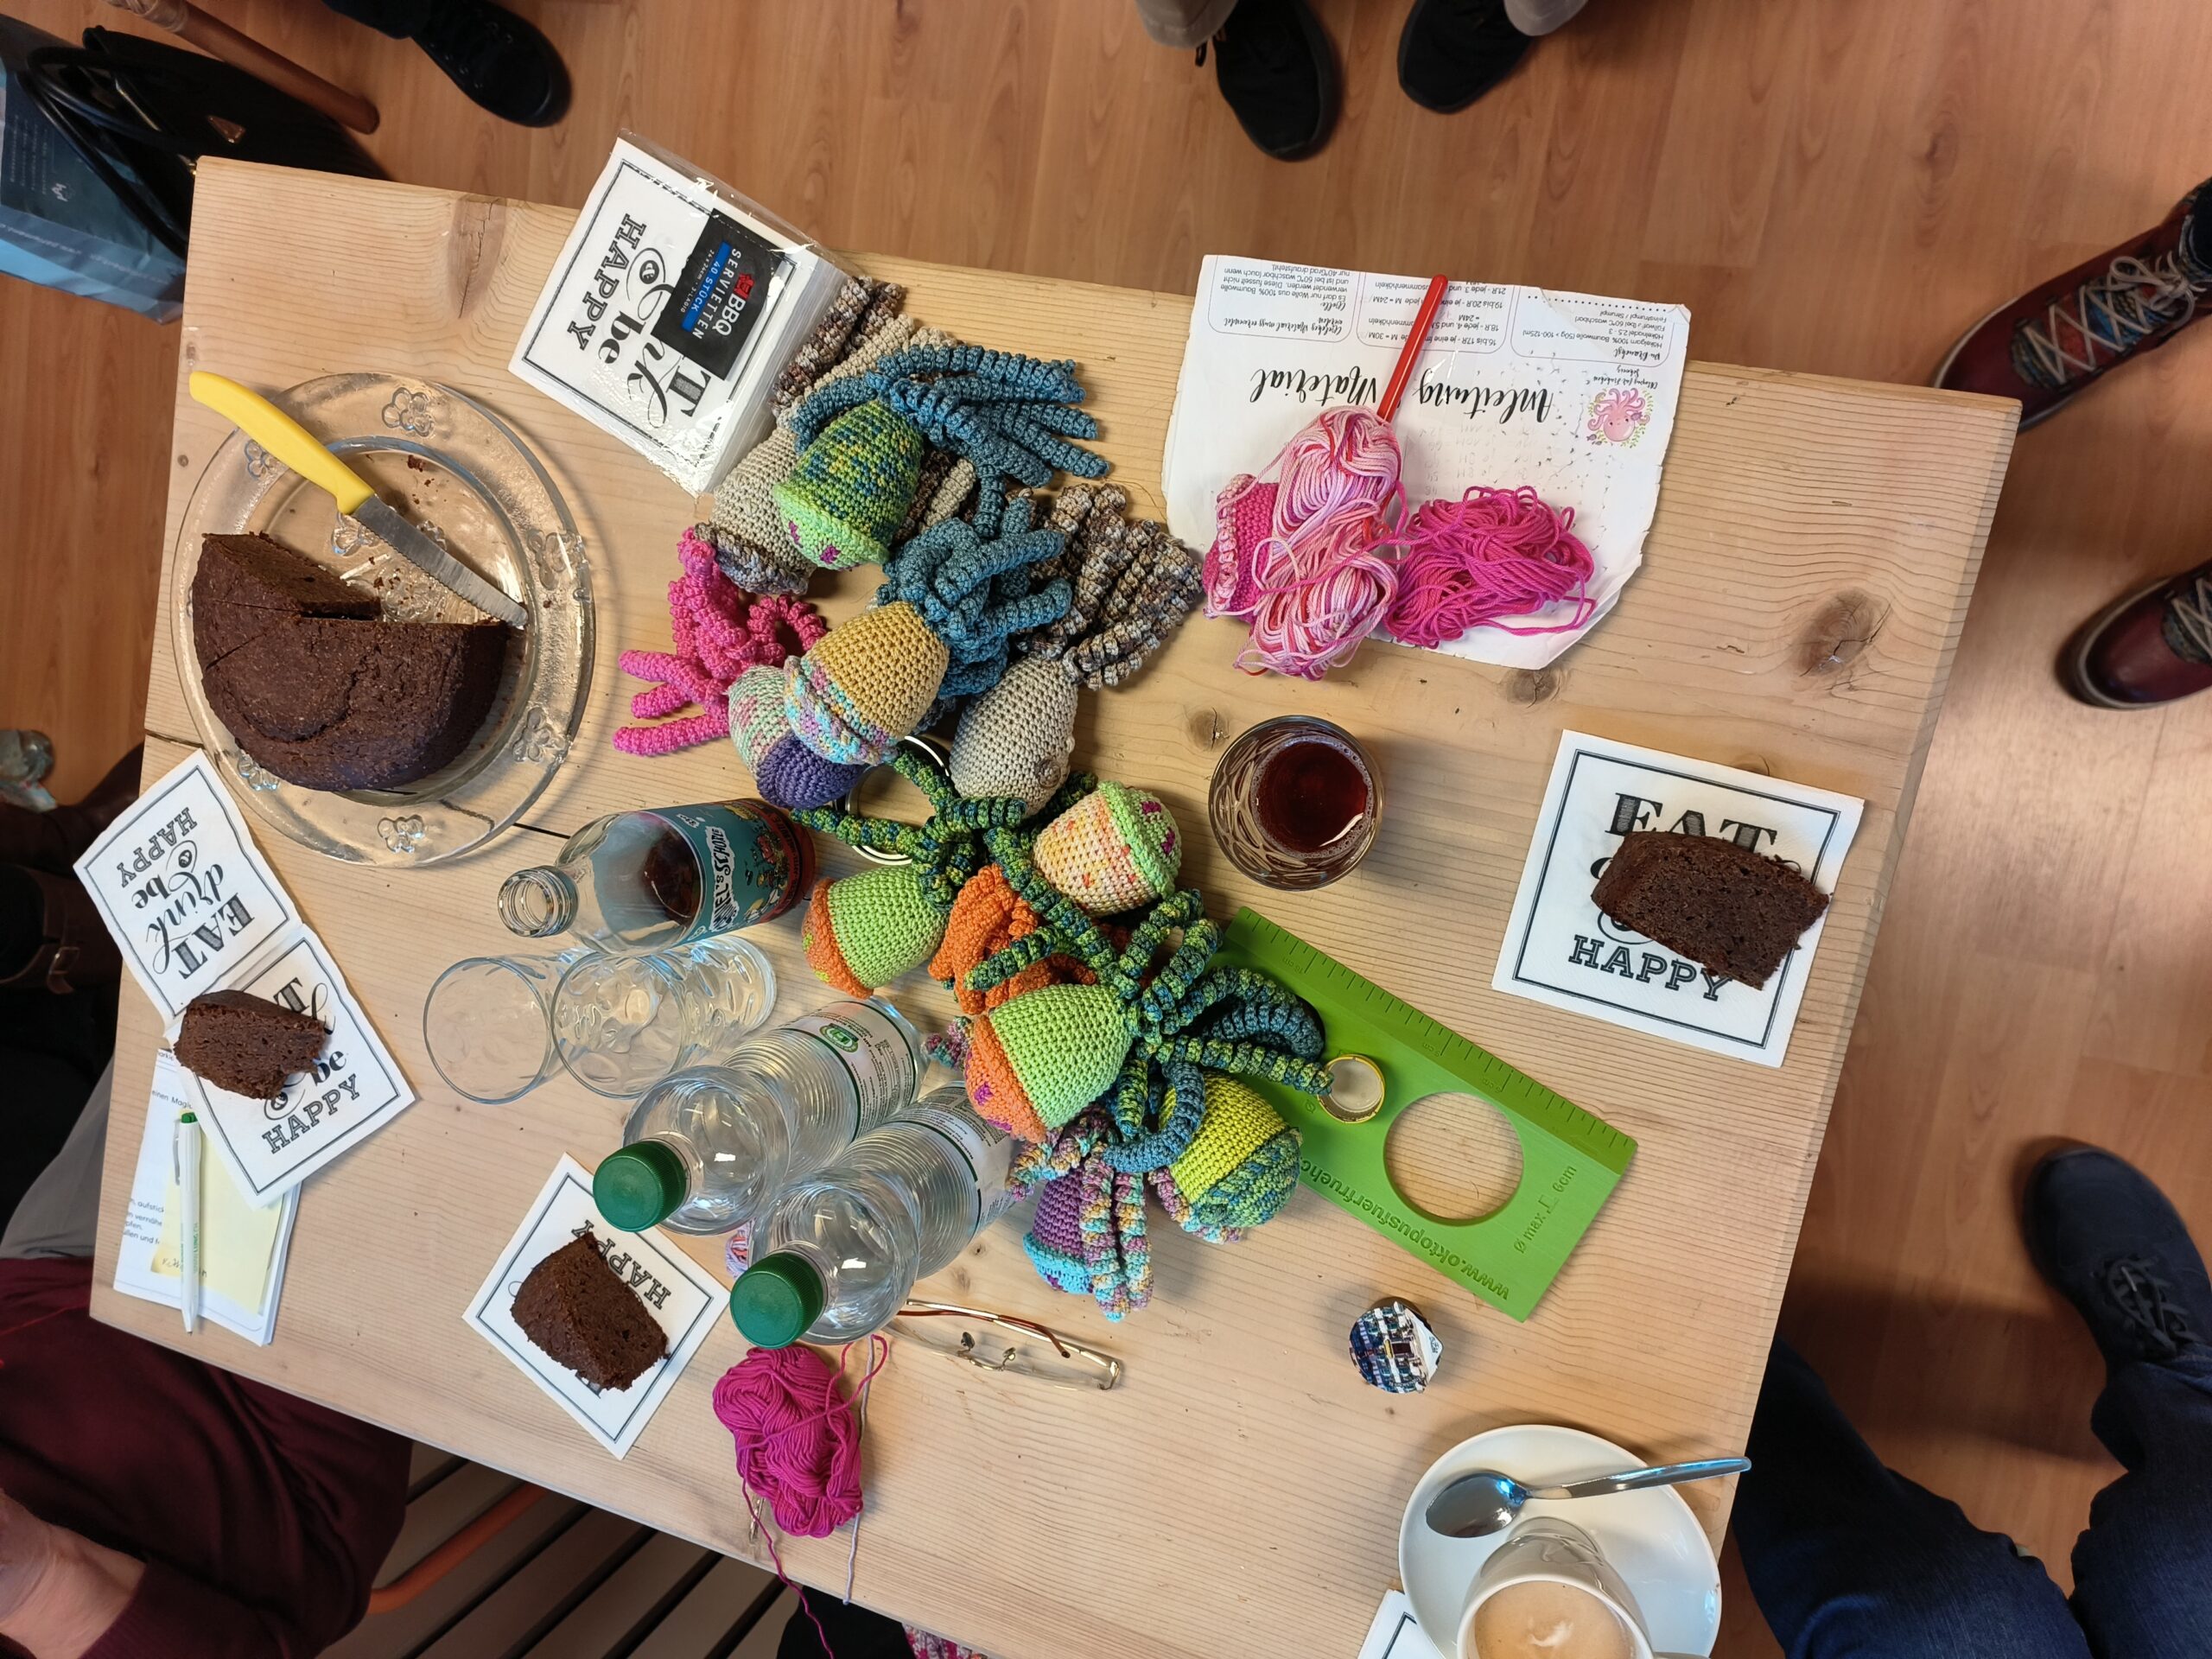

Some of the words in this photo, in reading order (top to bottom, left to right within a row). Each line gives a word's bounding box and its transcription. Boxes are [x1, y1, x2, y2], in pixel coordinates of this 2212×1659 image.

[567, 213, 646, 351] HAPPY
[709, 260, 721, 274] 40
[1262, 271, 1295, 280] waschbar
[691, 276, 714, 312] STÜCK
[692, 249, 742, 340] SERVIETTEN
[1220, 284, 1255, 293] Baumwolle
[1313, 284, 1347, 293] verwendet
[1404, 296, 1420, 305] jede
[1448, 284, 1461, 293] und
[1471, 285, 1486, 295] jede
[714, 294, 746, 336] BBQ
[1368, 316, 1414, 327] ammenhäkeln
[1463, 321, 1478, 330] jede
[1574, 315, 1607, 325] waschbar)
[598, 310, 645, 365] be
[1576, 333, 1609, 342] Baumwolle
[1629, 330, 1663, 339] Häkelnadel
[1249, 365, 1376, 404] Material
[1412, 367, 1553, 423] Anleitung
[116, 807, 197, 887] HAPPY
[129, 875, 168, 910] be
[145, 865, 222, 972] drink
[169, 893, 254, 979] EAT
[1567, 933, 1734, 1003] HAPPY
[261, 1074, 359, 1154] HAPPY
[1294, 1156, 1510, 1300] www.oktopusfuerfruehc
